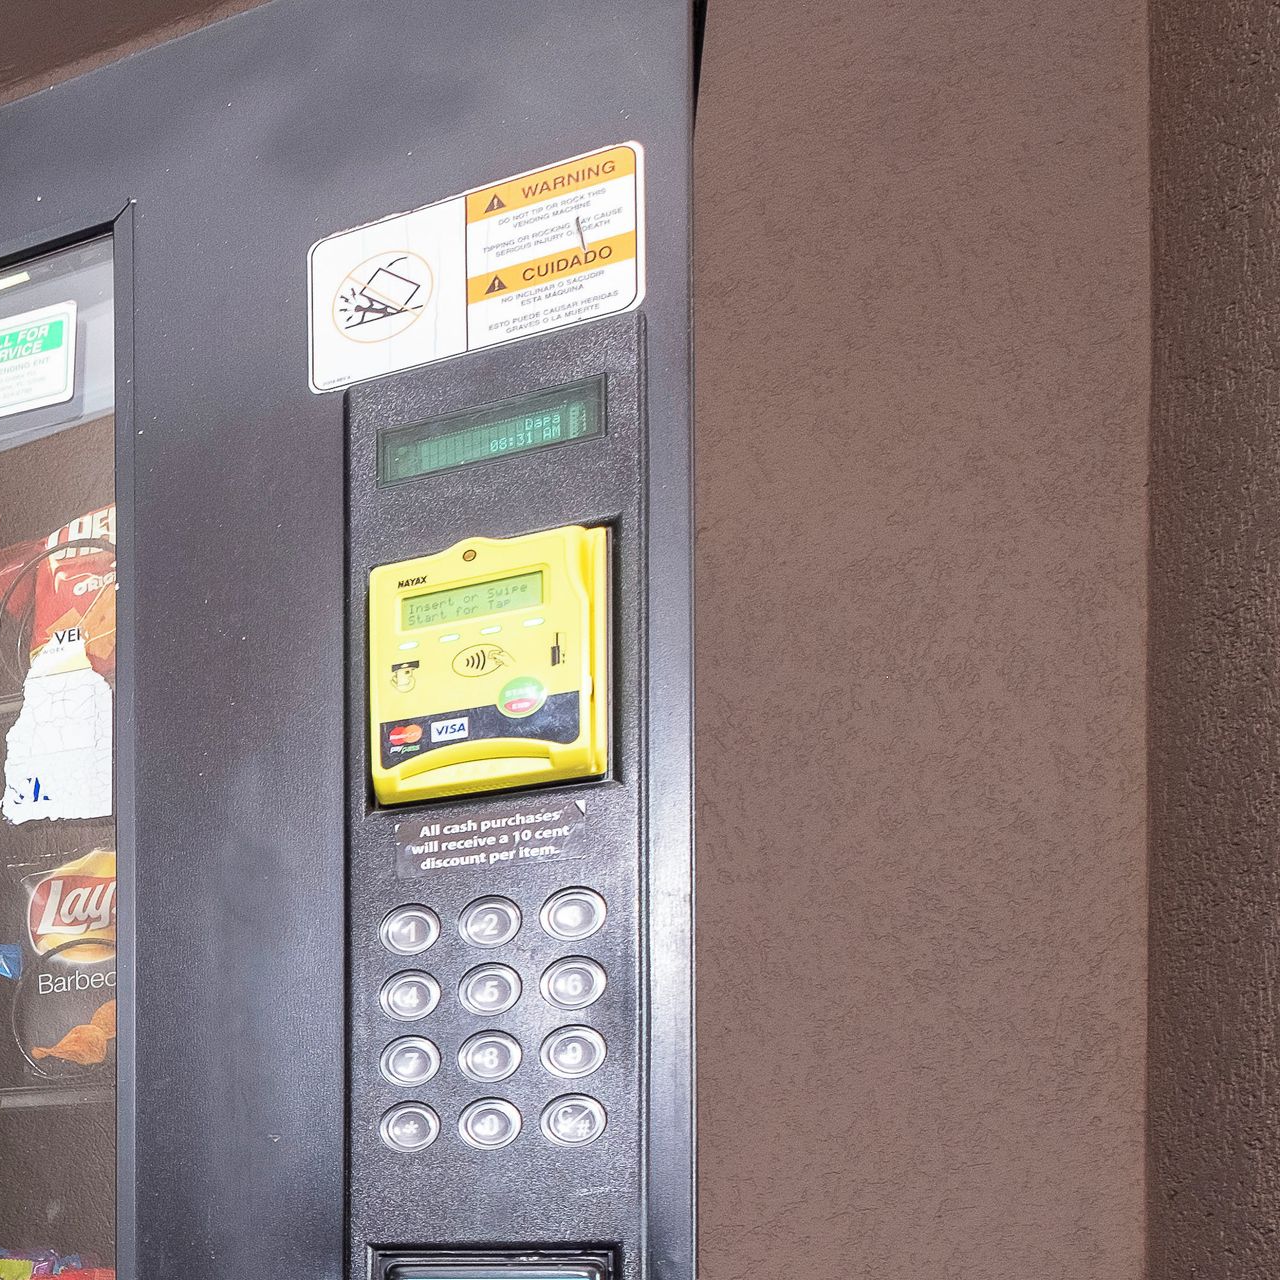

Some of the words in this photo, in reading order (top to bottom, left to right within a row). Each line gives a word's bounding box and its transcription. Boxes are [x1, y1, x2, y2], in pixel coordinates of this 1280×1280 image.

[521, 161, 616, 198] WARNING
[512, 211, 529, 221] NOT
[531, 206, 544, 216] TIP
[560, 195, 585, 207] ROCK
[587, 188, 607, 198] THIS
[513, 213, 550, 228] VENDING
[552, 201, 592, 217] MACHINE
[531, 223, 571, 239] ROCKING
[593, 207, 624, 221] CAUSE
[534, 233, 564, 247] INJURY
[582, 219, 611, 232] DEATH
[522, 245, 613, 281] CUIDADO
[501, 295, 514, 304] NO
[516, 284, 555, 300] INCLINAR
[566, 270, 605, 285] SACUDIR
[520, 296, 542, 306] ESTA
[488, 320, 510, 331] ESTO
[512, 311, 541, 324] PUEDE
[543, 302, 578, 316] CAUSAR
[580, 290, 619, 305] HERIDAS
[506, 319, 540, 334] GRAVES
[564, 303, 601, 317] MUERTE
[16, 324, 50, 343] FOR
[489, 431, 534, 453] 08:31
[542, 426, 561, 442] AM
[397, 575, 428, 589] NAYAX
[409, 597, 455, 615] Insert
[464, 594, 479, 603] or
[487, 583, 528, 599] Swipe
[408, 611, 447, 626] Start
[456, 605, 479, 617] for
[436, 722, 466, 736] VISA
[419, 824, 441, 838] All
[442, 819, 478, 835] cash
[480, 810, 562, 832] purchases
[411, 841, 439, 855] will
[442, 835, 497, 851] receive
[498, 834, 509, 844] a
[512, 829, 533, 843] 10
[534, 825, 570, 840] cent
[420, 853, 487, 871] discount
[489, 849, 516, 864] per
[518, 844, 560, 858] item.
